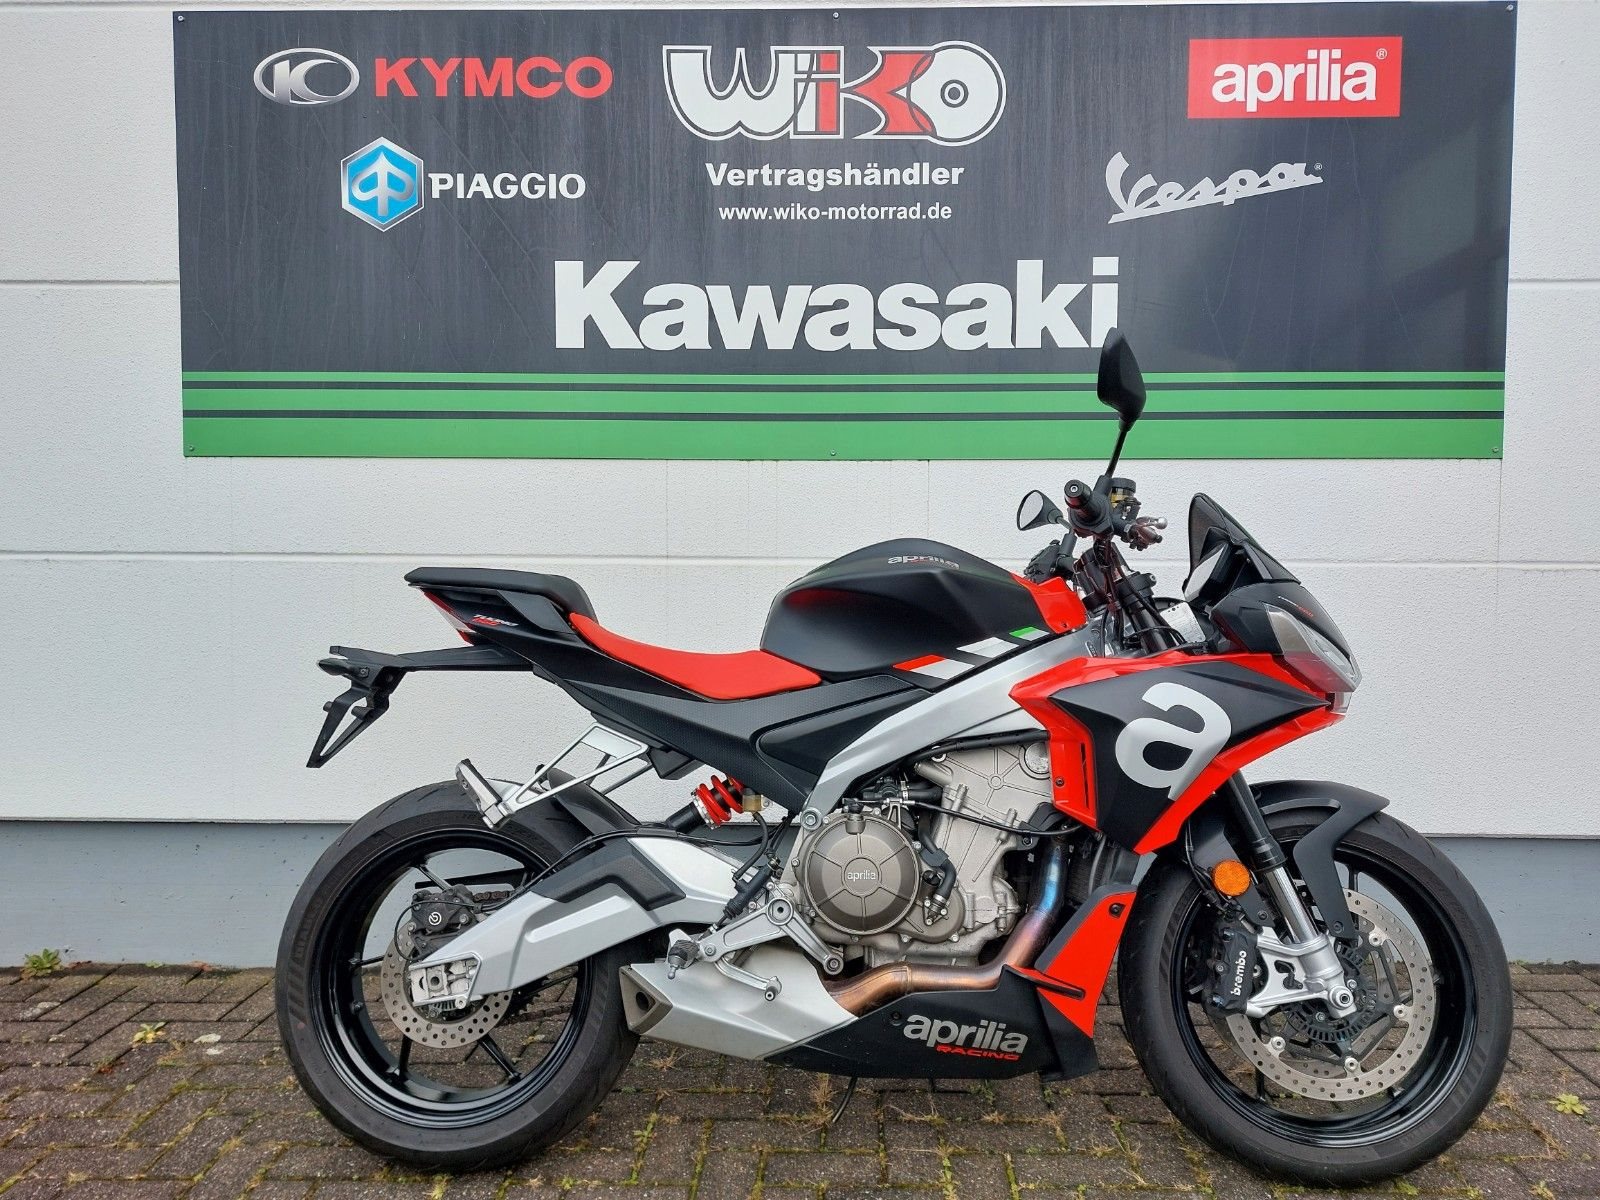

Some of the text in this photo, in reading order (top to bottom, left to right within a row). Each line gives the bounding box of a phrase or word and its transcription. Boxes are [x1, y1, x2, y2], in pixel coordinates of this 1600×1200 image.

[375, 56, 612, 98] KYMCO
[1212, 48, 1377, 112] aprilia
[428, 172, 586, 200] PIAGGIO
[705, 161, 965, 192] Vertragshändler
[1105, 151, 1323, 224] Vespa
[718, 201, 953, 221] www.wiko-motorrad.de
[554, 256, 1120, 352] Kawasaki
[847, 869, 876, 882] aprilia
[1230, 950, 1247, 996] brembo
[903, 1014, 1029, 1054] aprilia
[936, 1044, 1020, 1061] RACING
